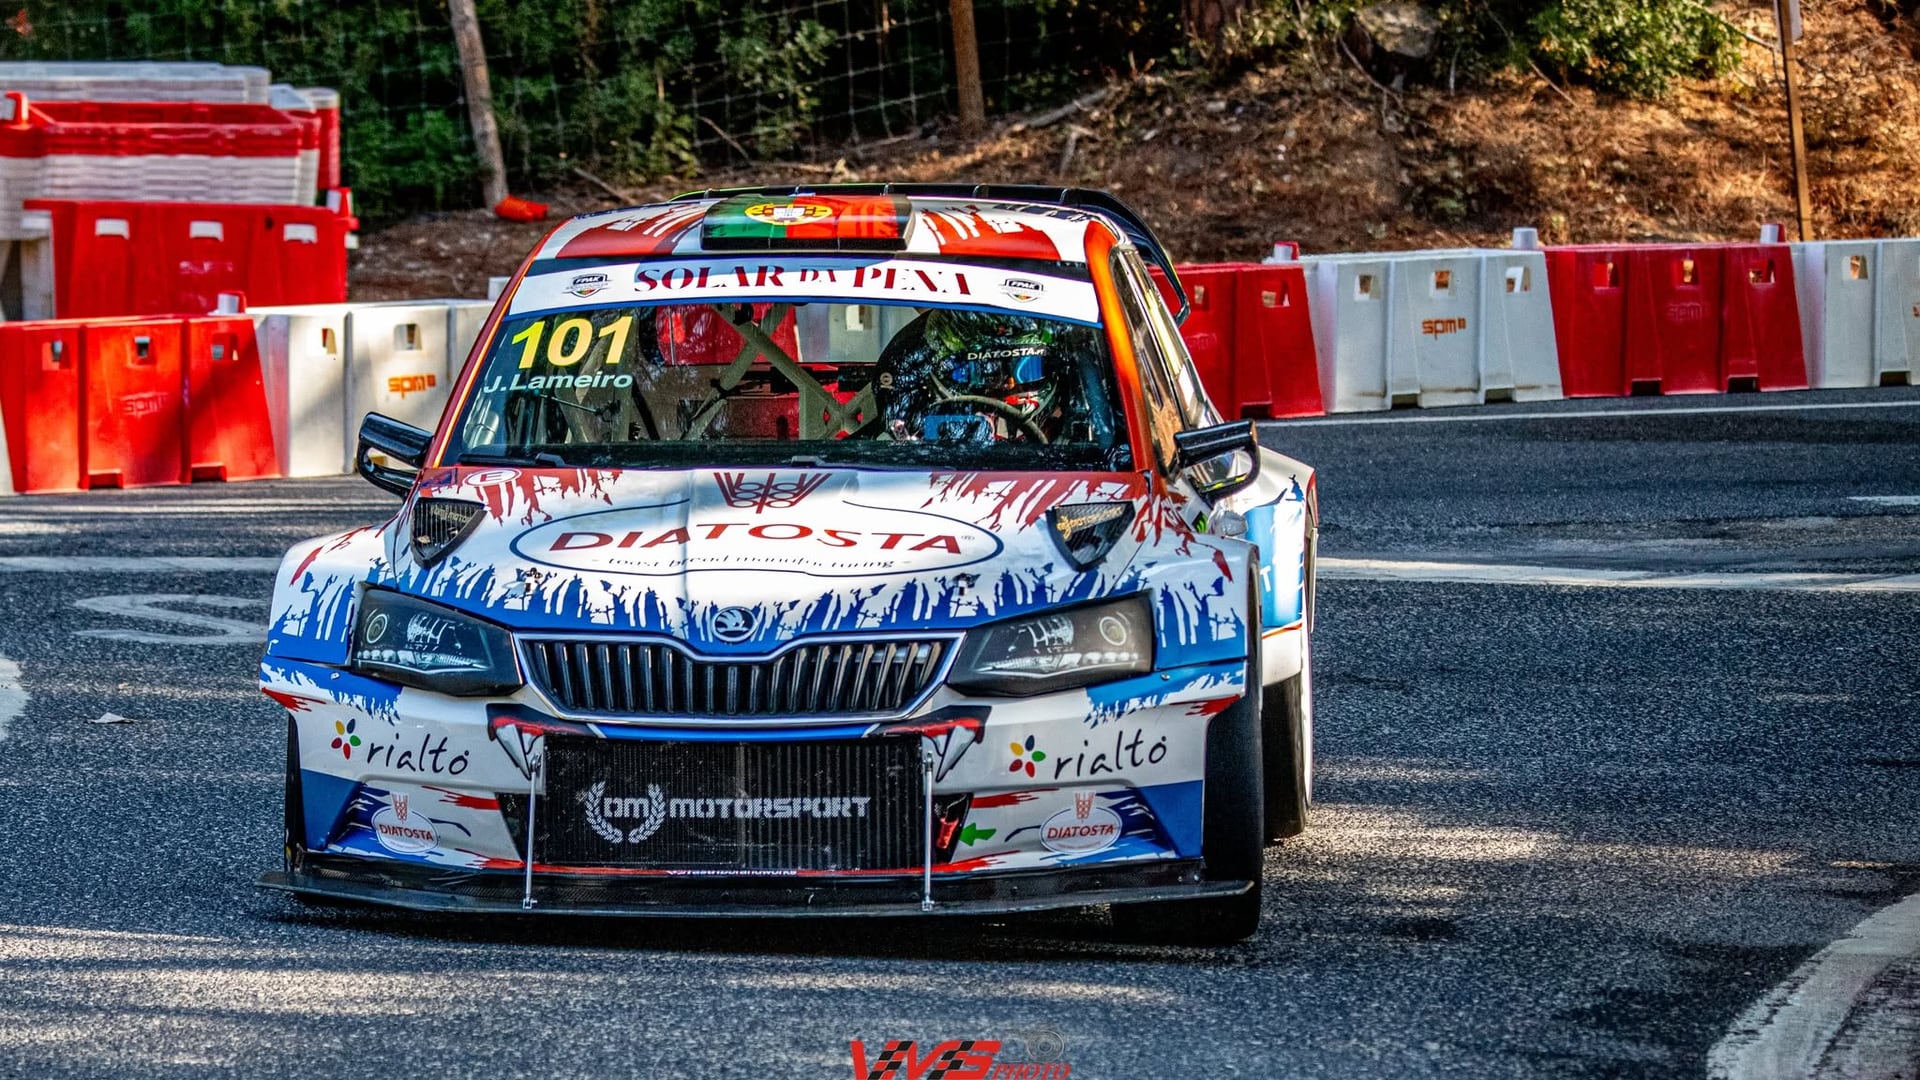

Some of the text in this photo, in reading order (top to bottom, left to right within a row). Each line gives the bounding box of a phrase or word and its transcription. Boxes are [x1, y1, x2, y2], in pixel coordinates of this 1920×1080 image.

[634, 264, 785, 292] SOLAR
[799, 268, 837, 283] DA
[511, 315, 634, 370] 101
[483, 370, 634, 394] J.Lameiro
[549, 522, 962, 555] DIATOSTA
[669, 796, 872, 818] MOTORSPORT
[378, 824, 435, 842] DIATOSTA
[1046, 824, 1115, 839] DIATOSTA
